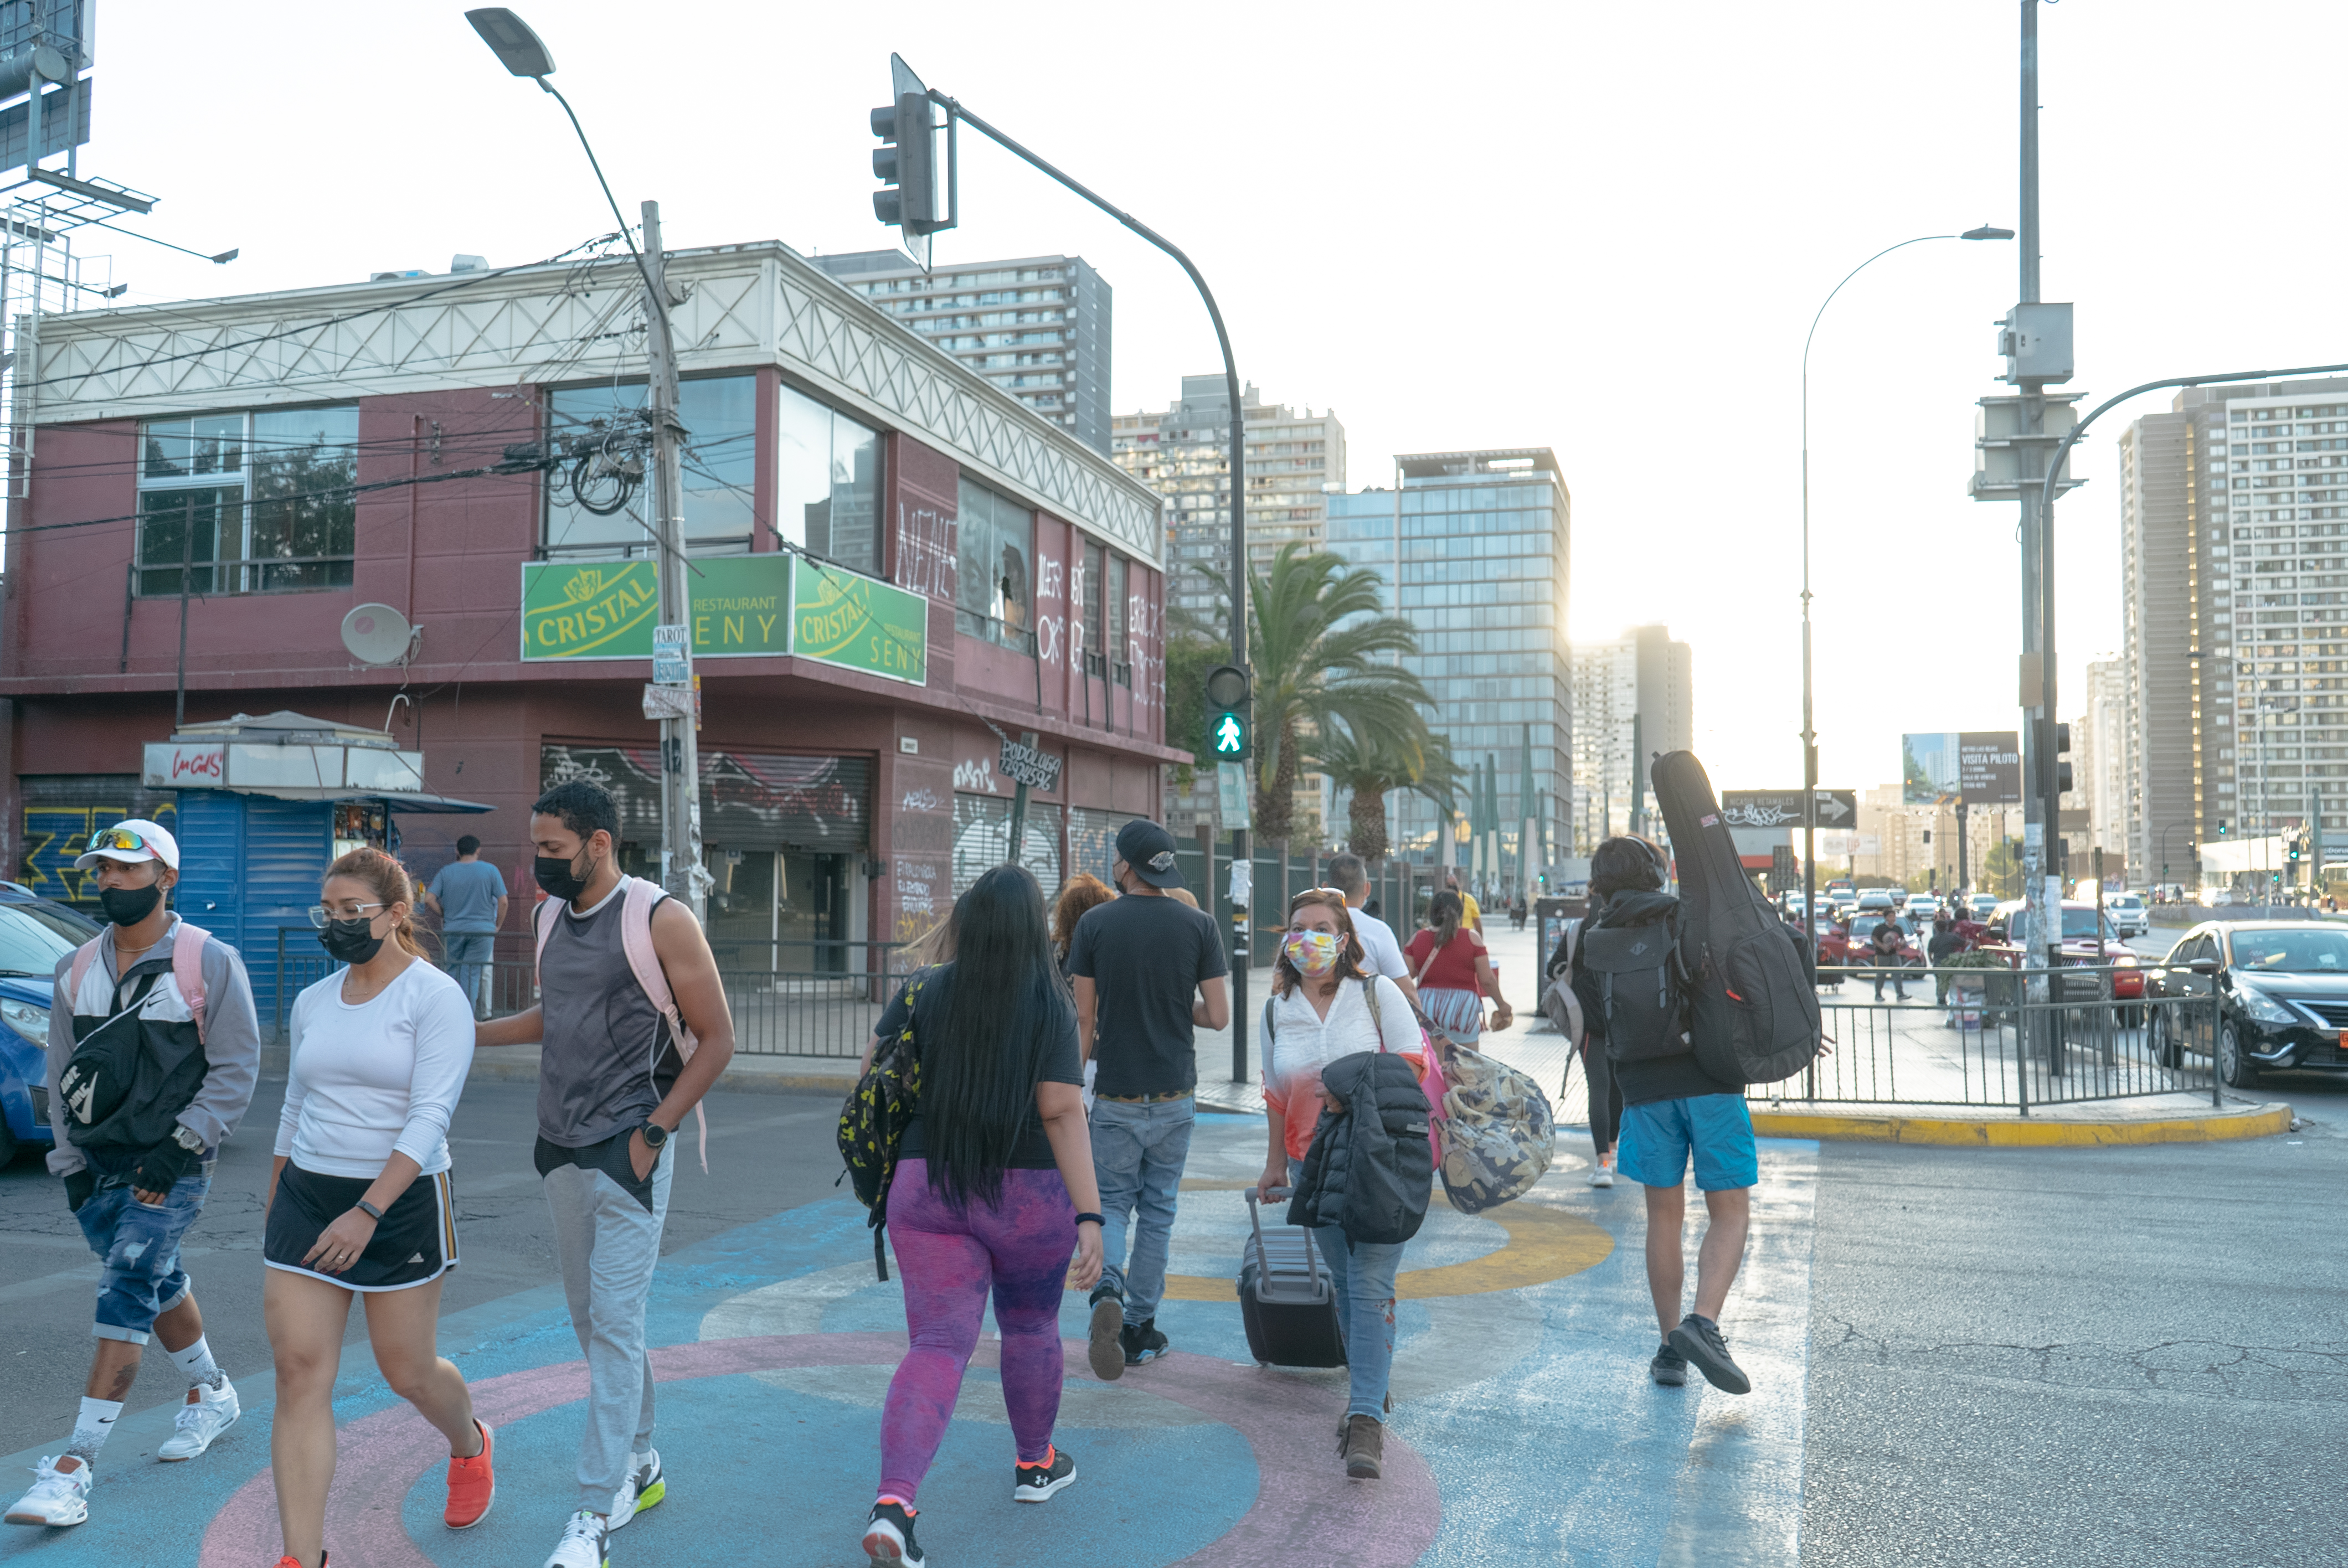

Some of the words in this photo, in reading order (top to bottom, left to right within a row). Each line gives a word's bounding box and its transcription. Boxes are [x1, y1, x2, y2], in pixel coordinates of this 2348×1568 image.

[537, 579, 656, 647] CRISTAL
[693, 596, 777, 612] RESTAURANT
[696, 614, 777, 644] ENY
[802, 593, 867, 644] CRISTAL
[656, 628, 686, 644] TAROT
[871, 636, 921, 673] SENY
[1001, 739, 1062, 775] PODOLOGA
[1961, 753, 1988, 765] VISITA
[1990, 752, 2018, 764] PILOTO
[1729, 797, 1754, 806] NICASIO
[1757, 797, 1794, 806] RETAMALES
[1847, 838, 1860, 853] UP
[68, 1082, 90, 1109] NIKE
